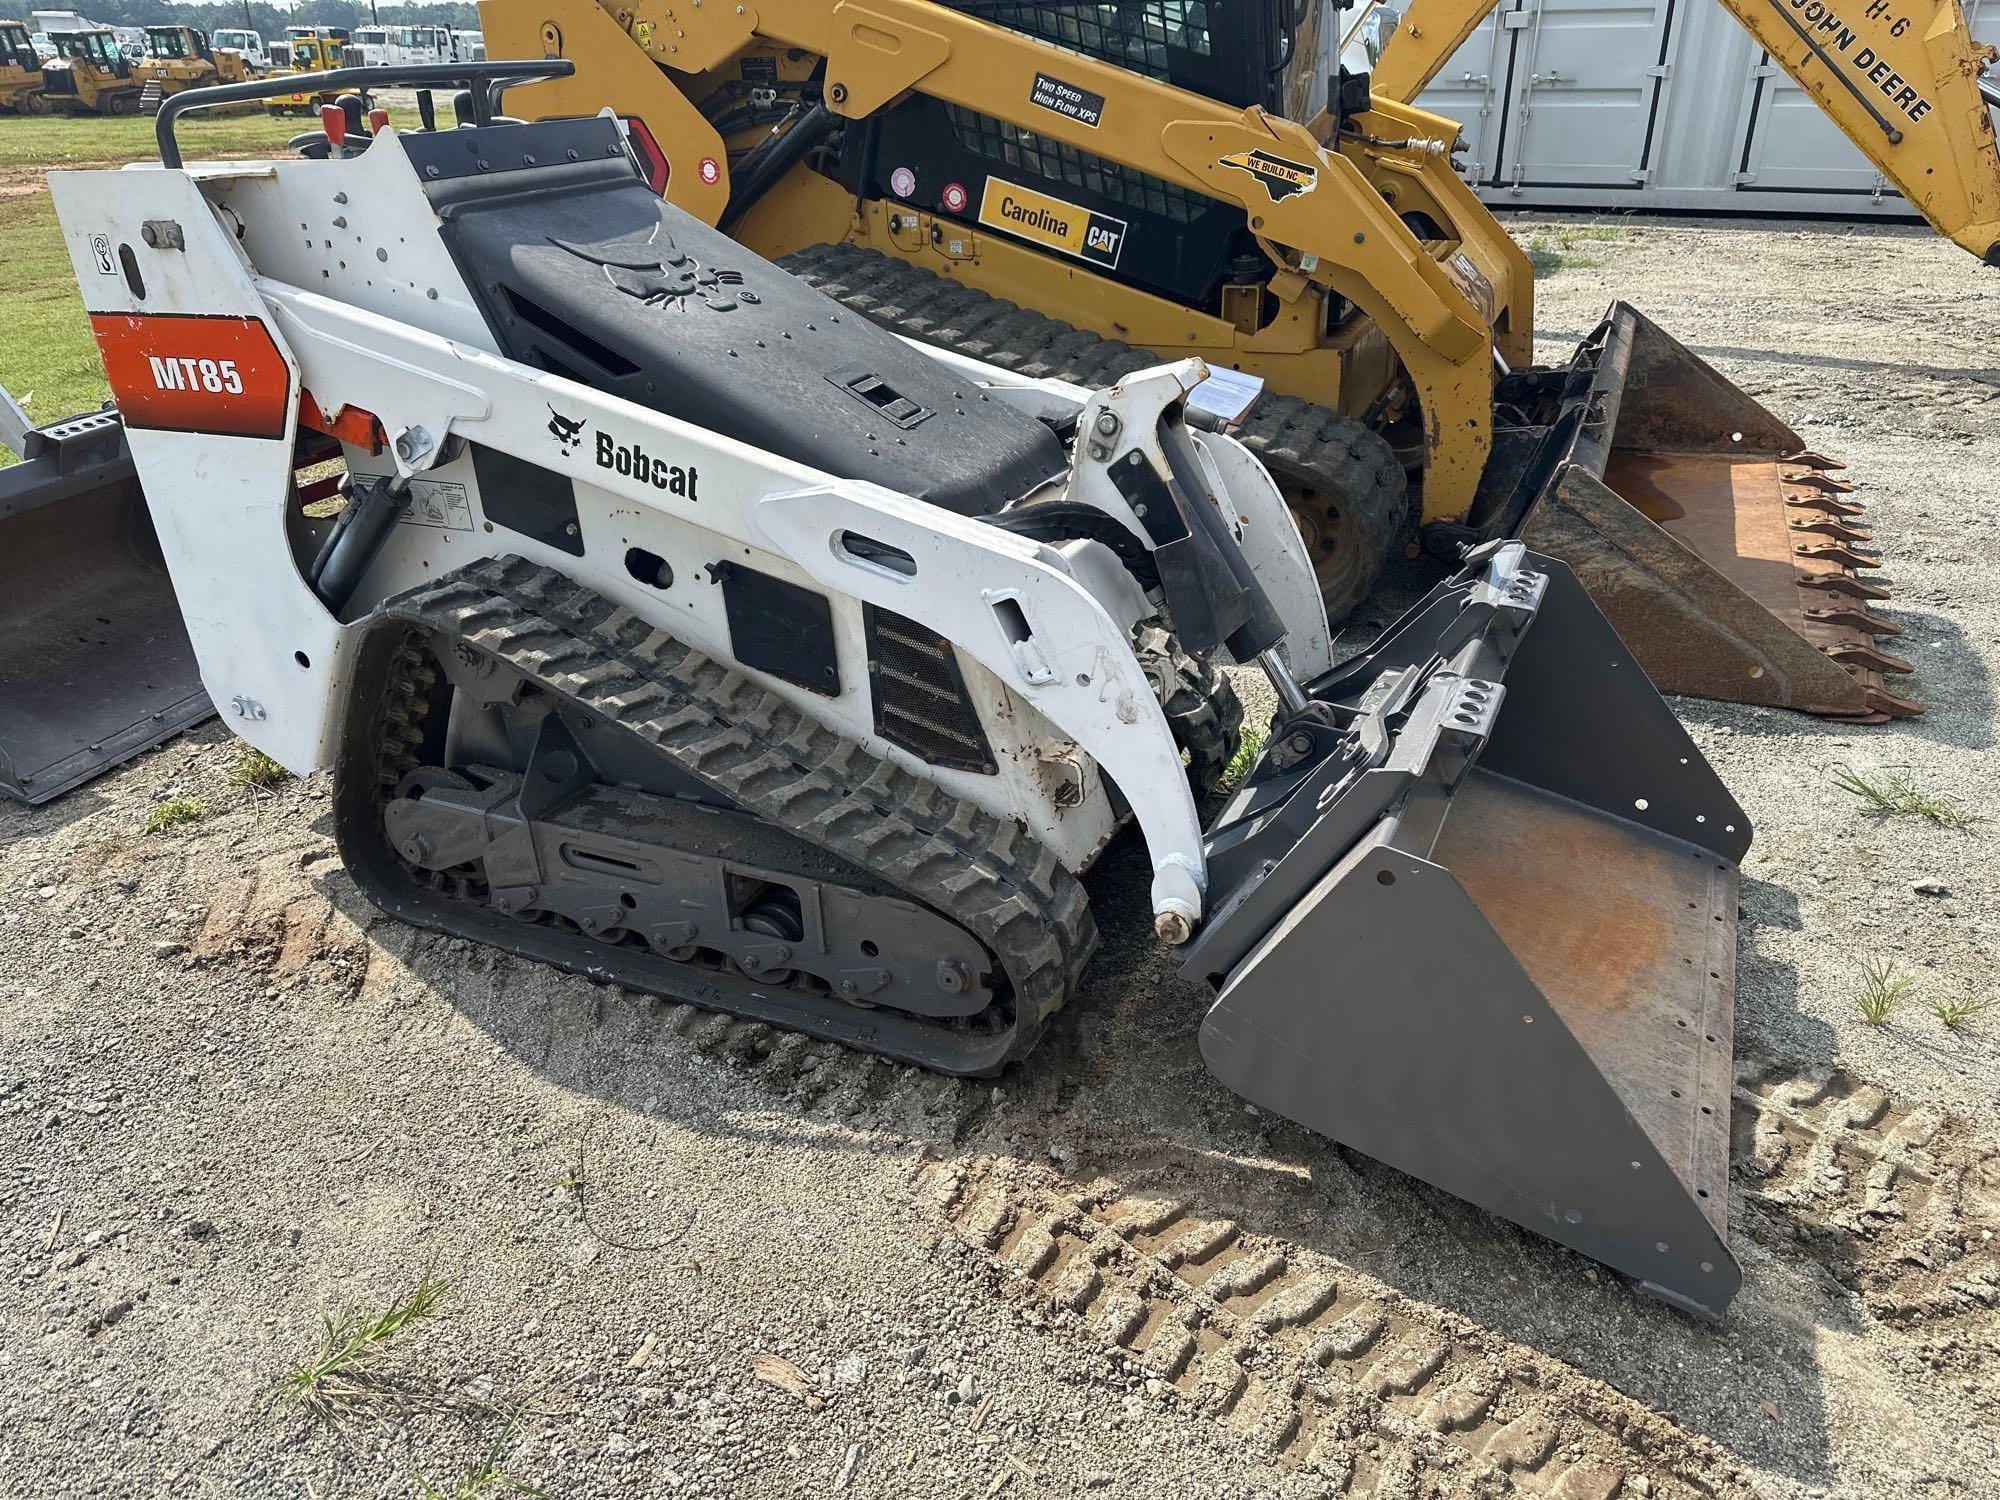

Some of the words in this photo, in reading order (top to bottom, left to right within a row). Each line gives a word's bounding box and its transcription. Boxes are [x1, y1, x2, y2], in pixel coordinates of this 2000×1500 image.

[1852, 47, 1933, 123] DEERE
[1077, 107, 1098, 123] XPS
[1247, 157, 1260, 170] WE
[1261, 162, 1285, 177] BUILD
[1286, 170, 1299, 181] NC
[1001, 197, 1069, 237] Carolina
[1087, 226, 1119, 253] CAT
[149, 356, 244, 395] MT85
[596, 430, 698, 502] Bobcat
